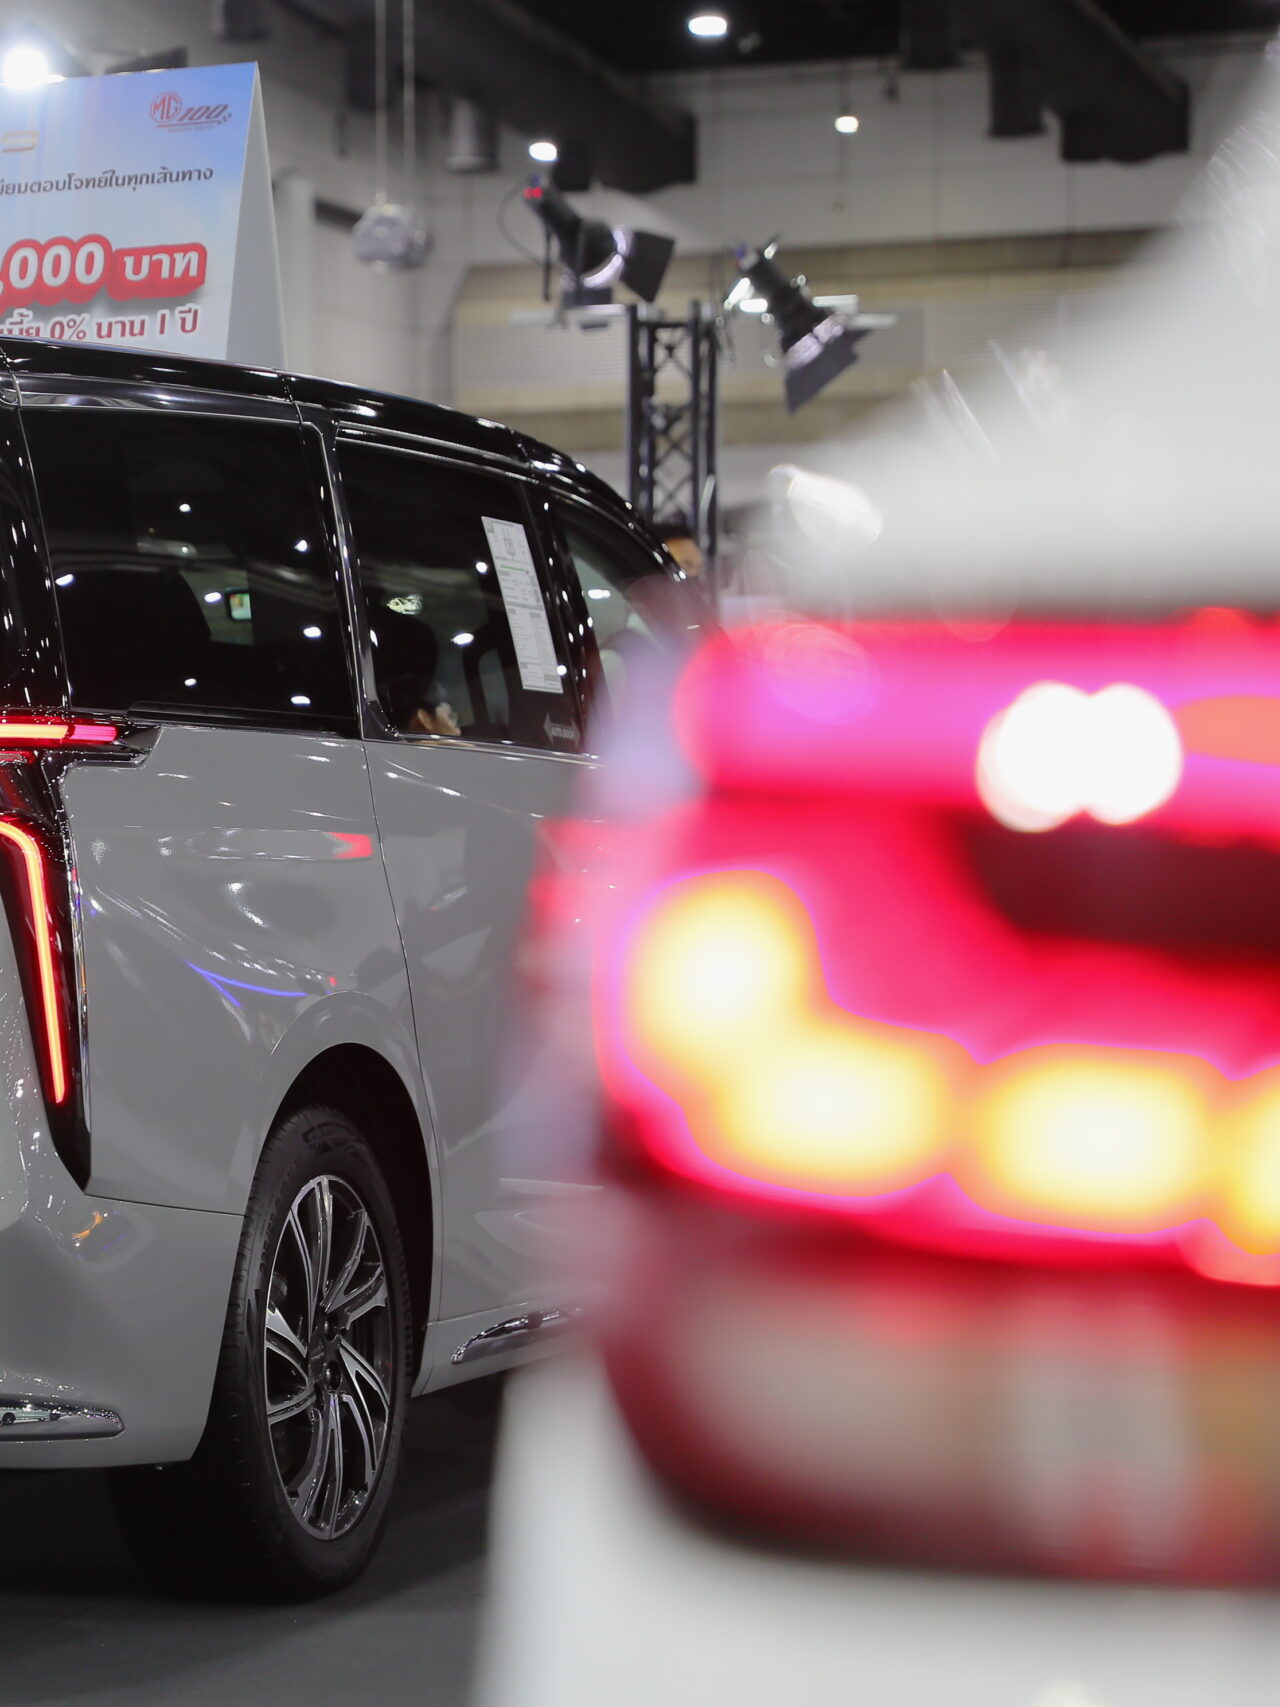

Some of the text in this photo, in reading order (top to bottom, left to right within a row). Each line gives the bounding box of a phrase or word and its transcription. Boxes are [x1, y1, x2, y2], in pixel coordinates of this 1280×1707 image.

[152, 94, 229, 121] MG 100
[124, 250, 200, 282] บาท
[49, 317, 87, 340] 0%
[96, 319, 146, 340] นาน
[179, 307, 200, 334] ปี
